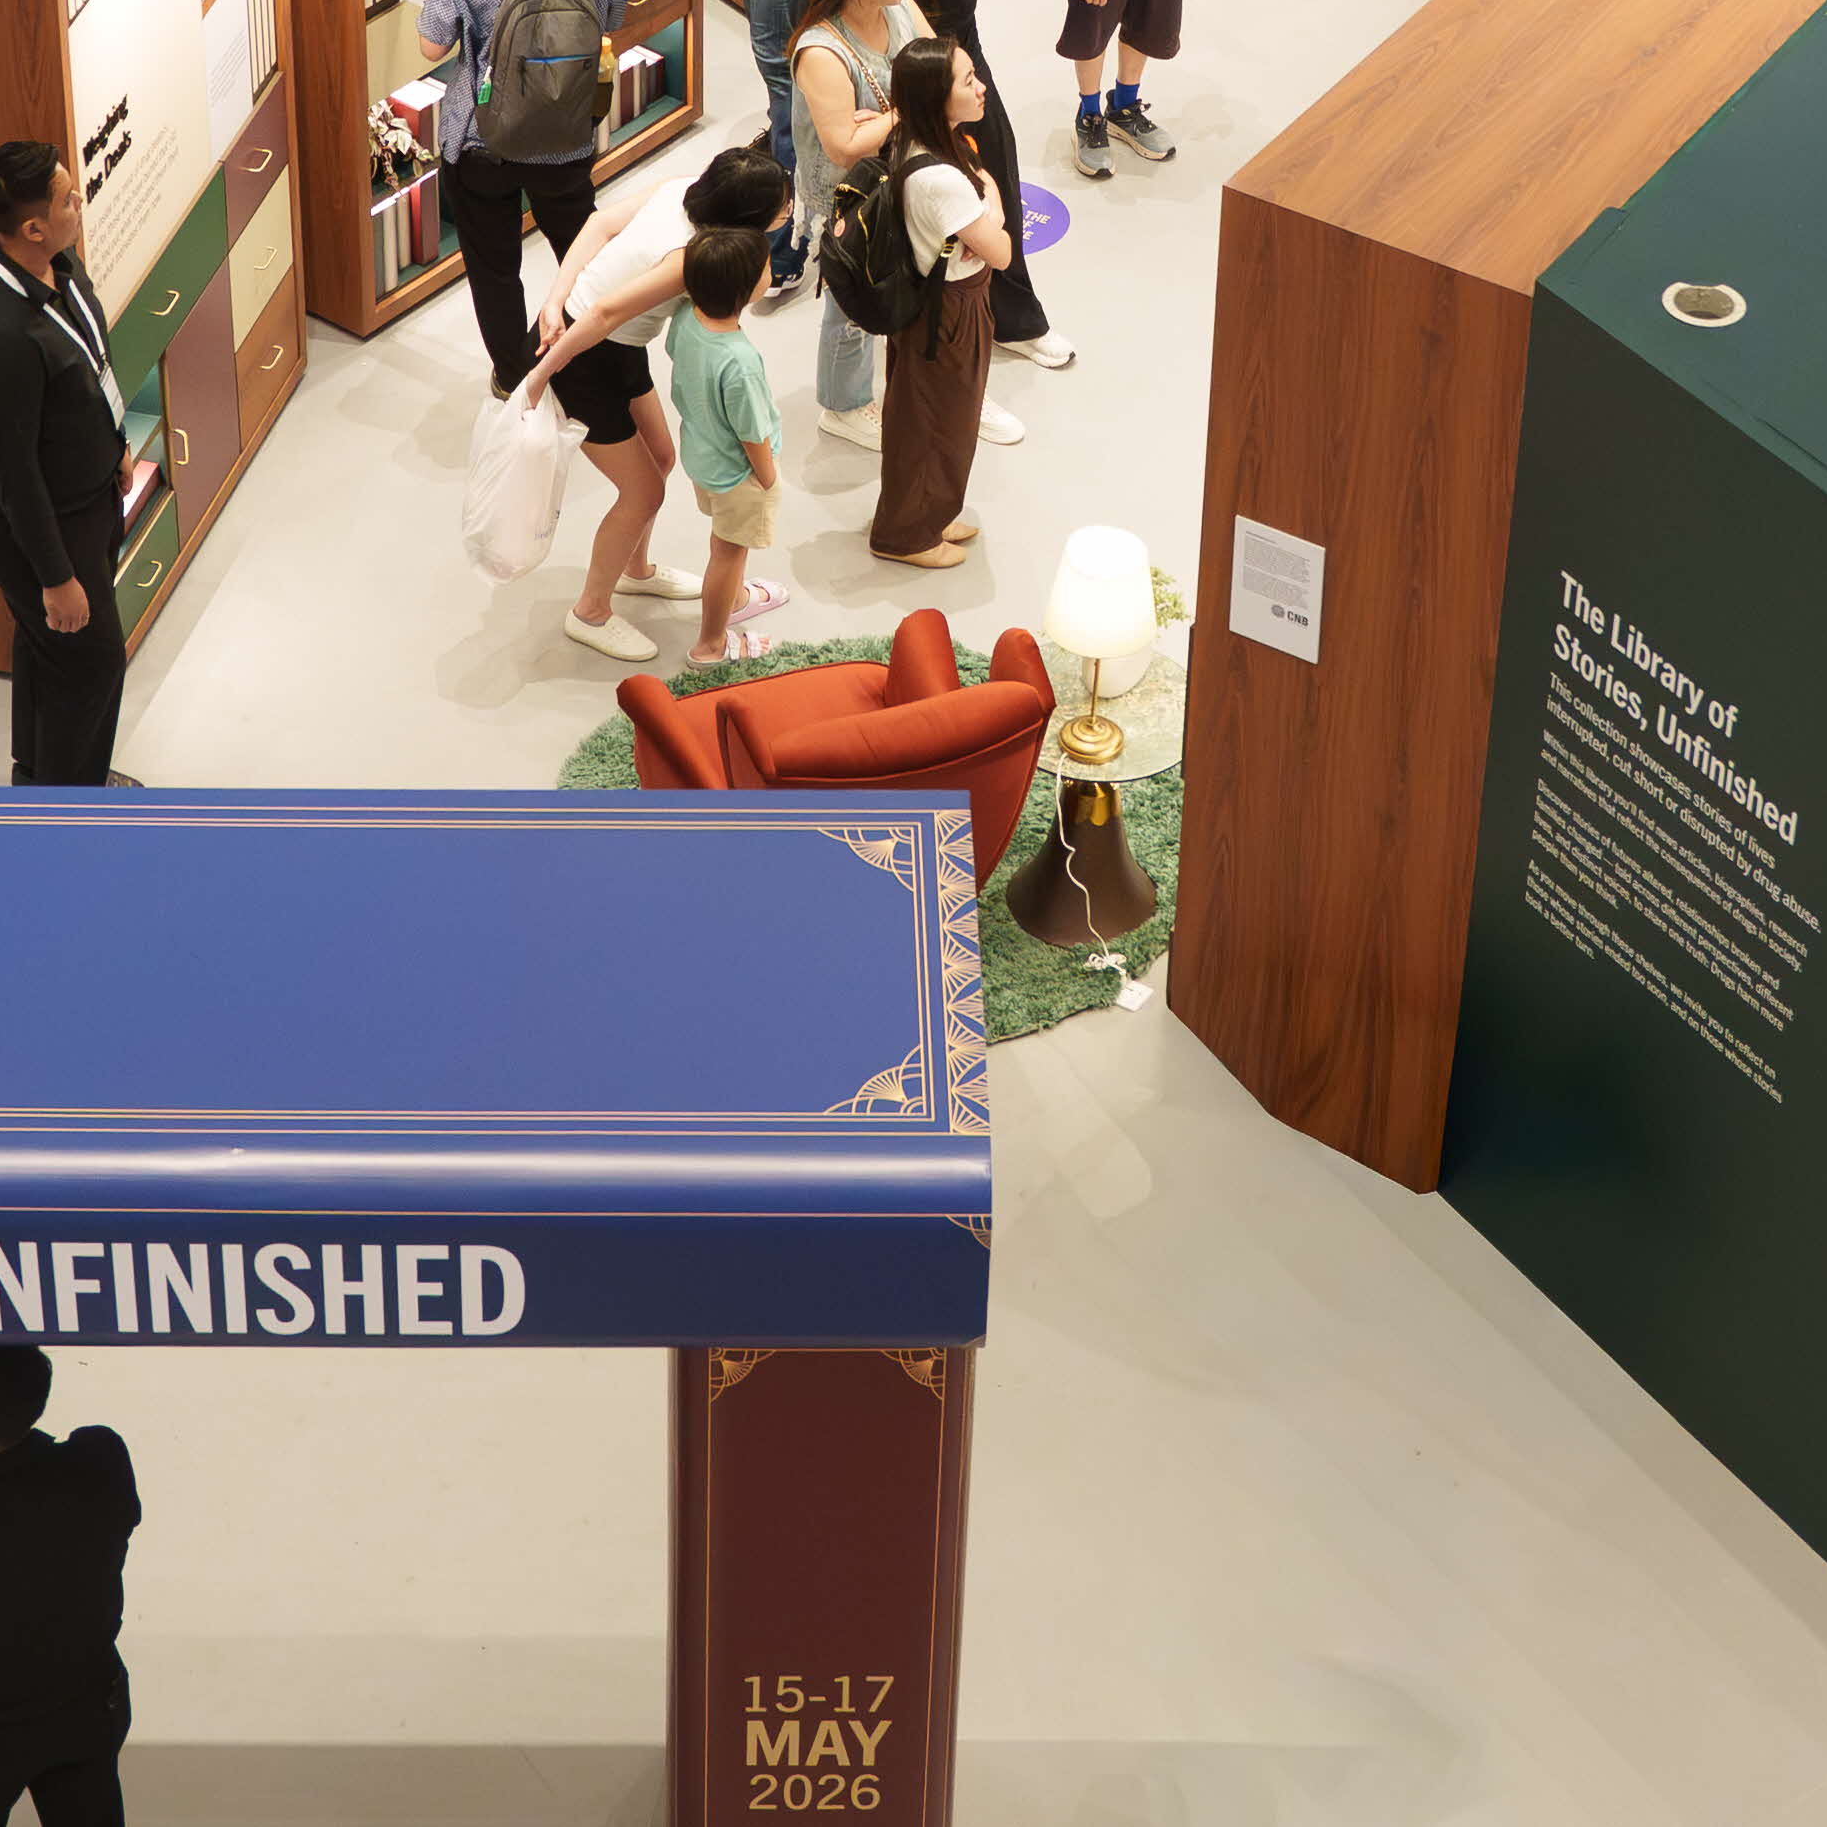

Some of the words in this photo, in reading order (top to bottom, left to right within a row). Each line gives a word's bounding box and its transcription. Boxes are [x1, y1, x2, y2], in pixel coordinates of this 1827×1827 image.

[86, 172, 103, 204] the
[1025, 210, 1051, 224] THE
[1287, 611, 1309, 627] CNB
[1561, 571, 1604, 634] The
[1611, 614, 1704, 715] Library
[1709, 701, 1738, 737] of
[1554, 624, 1647, 731] Stories,
[1657, 705, 1797, 845] Unfinished
[1551, 672, 1572, 703] This
[1574, 697, 1627, 749] collection
[1629, 742, 1691, 800] showcases
[1693, 794, 1732, 833] stories
[1734, 828, 1747, 845] of
[1748, 836, 1775, 869] lives
[1547, 695, 1610, 762] interrupted,
[1613, 755, 1632, 778] cut
[1633, 771, 1664, 803] short
[1666, 798, 1678, 813] or
[1680, 808, 1735, 861] disrupted
[1737, 851, 1752, 876] by
[1753, 869, 1781, 902] drug
[1782, 894, 1821, 933] abuse.
[745, 1676, 894, 1713] 15-17
[746, 1720, 892, 1766] MAY
[749, 1774, 880, 1810] 2026
